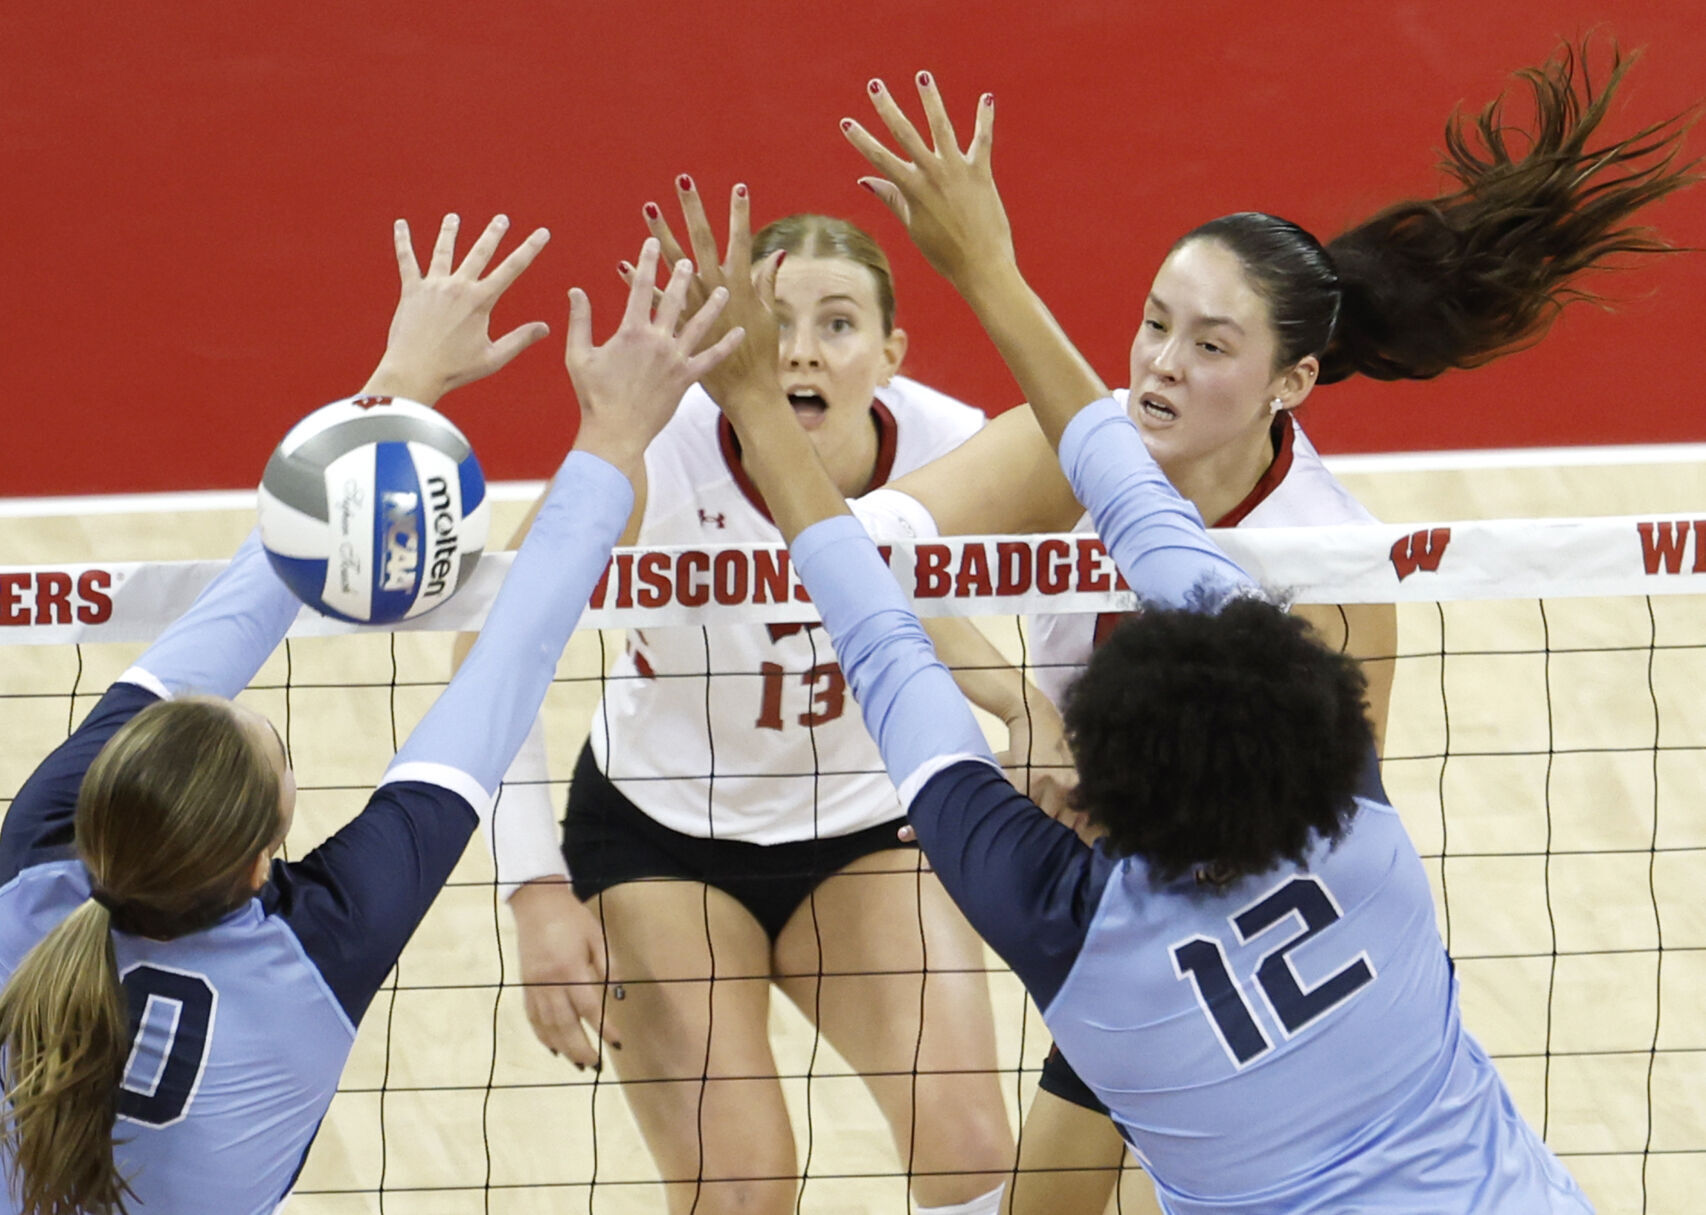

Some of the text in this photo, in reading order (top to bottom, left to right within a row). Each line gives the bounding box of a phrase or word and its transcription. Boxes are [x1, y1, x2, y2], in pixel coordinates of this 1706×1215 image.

[379, 491, 419, 595] NCAA
[423, 476, 458, 598] molten
[589, 539, 1130, 609] ISCON BADGE
[755, 661, 846, 732] 13
[1167, 873, 1378, 1072] 12
[115, 961, 220, 1130] 0
